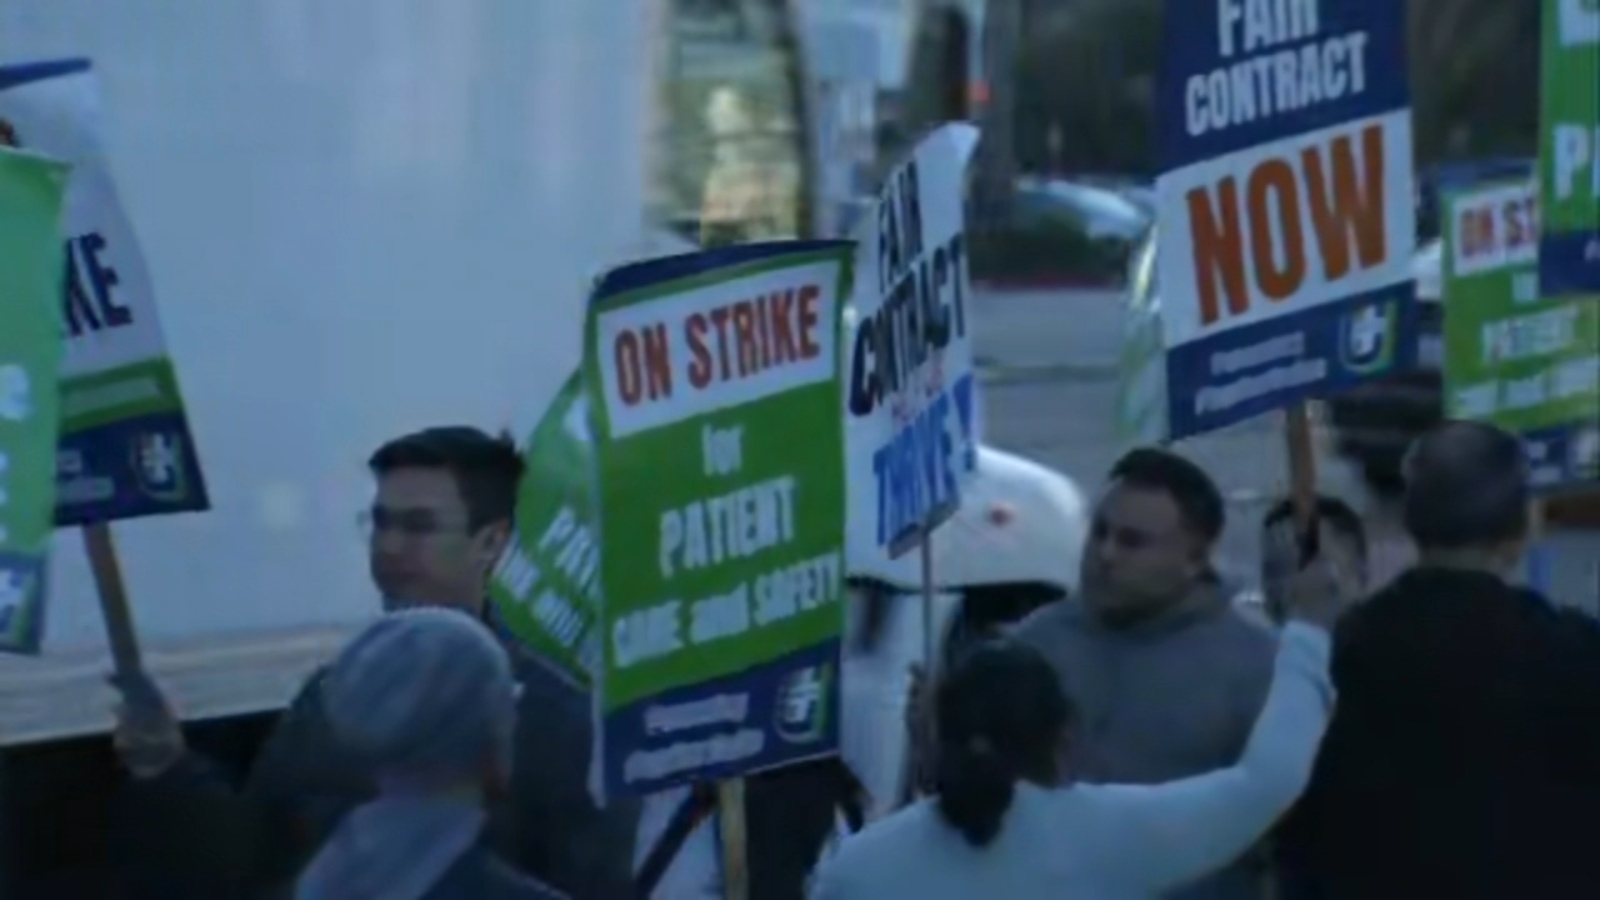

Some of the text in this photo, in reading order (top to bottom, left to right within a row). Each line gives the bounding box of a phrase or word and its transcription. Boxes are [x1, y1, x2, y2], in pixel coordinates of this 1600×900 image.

[1184, 30, 1368, 136] CONTRACT
[1186, 122, 1387, 328] NOW
[614, 328, 672, 407] ON
[684, 283, 821, 391] STRIKE
[848, 232, 966, 417] CONTRACT
[660, 474, 796, 579] PATIENT
